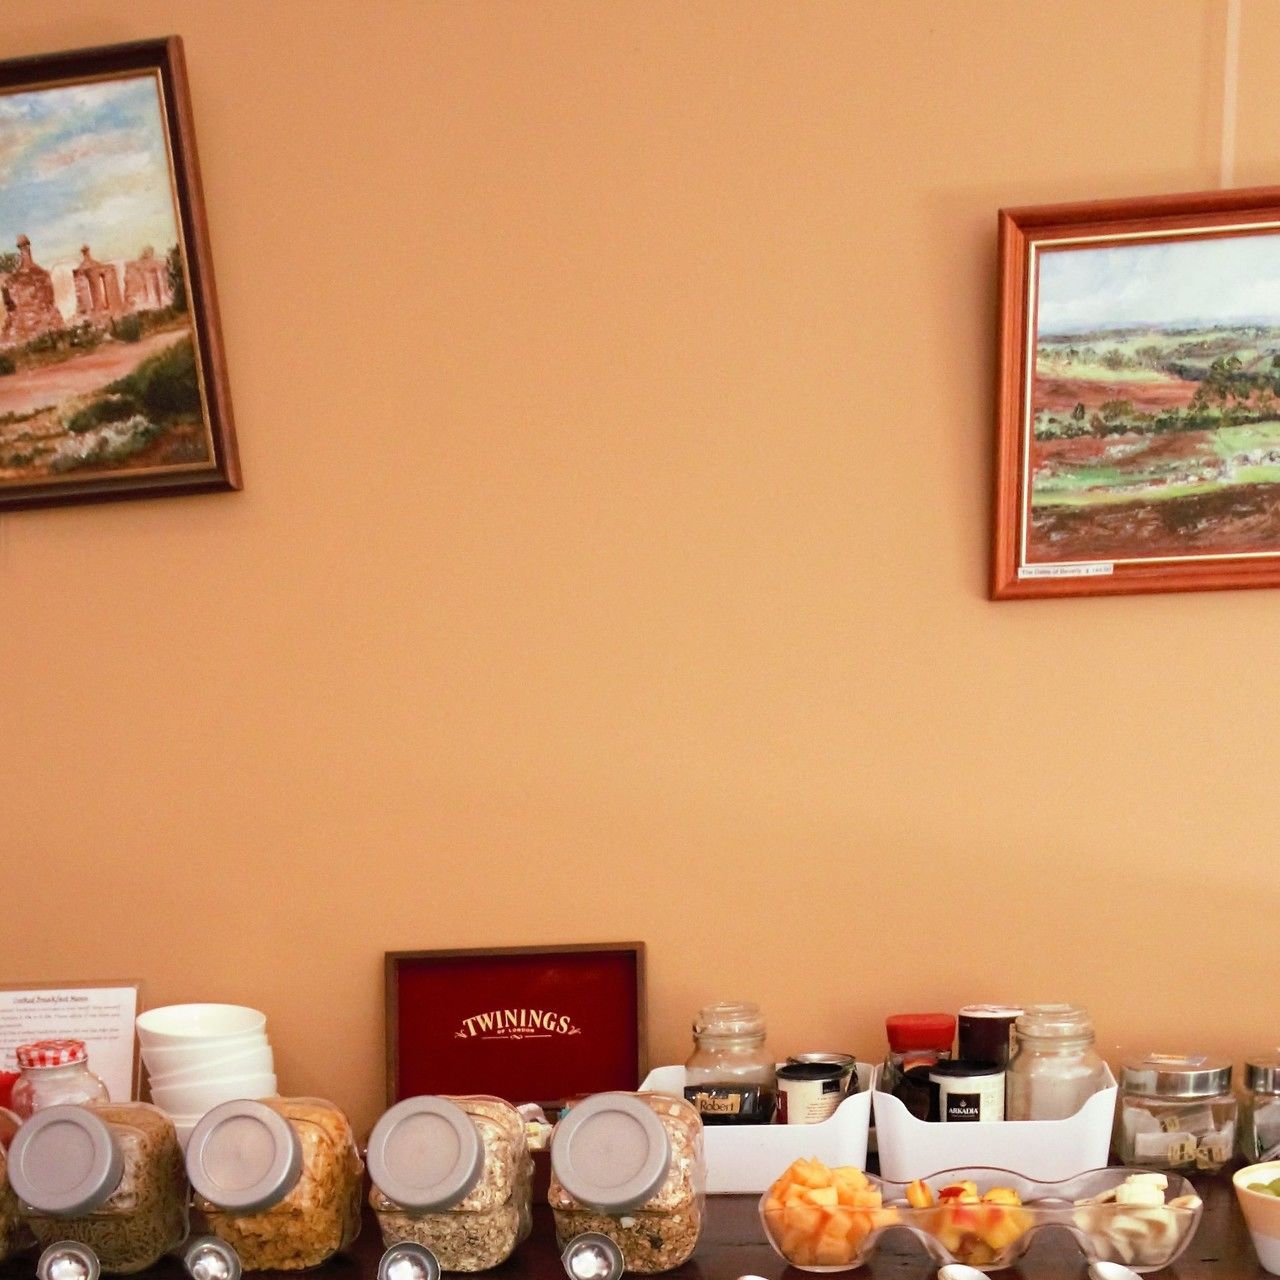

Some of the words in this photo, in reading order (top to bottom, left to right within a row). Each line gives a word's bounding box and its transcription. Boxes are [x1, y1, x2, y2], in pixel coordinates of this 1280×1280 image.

[462, 1008, 571, 1037] TWININGS
[700, 1098, 734, 1112] Robert
[948, 1107, 979, 1115] ARKADIA
